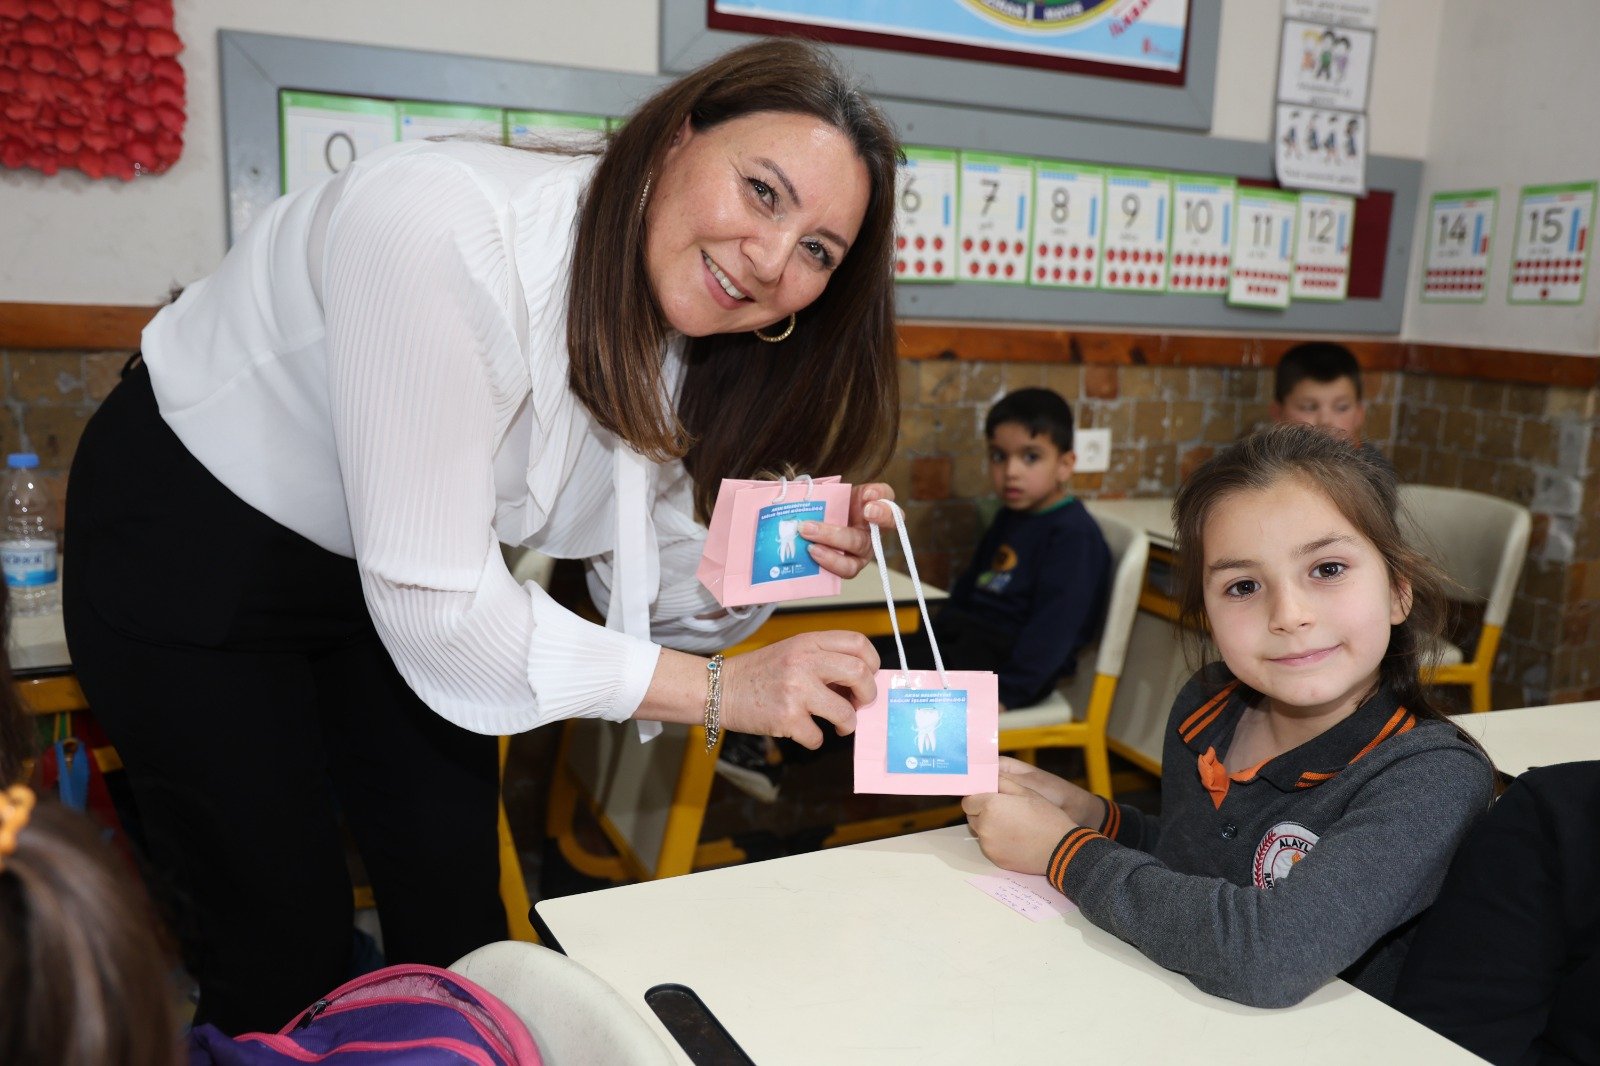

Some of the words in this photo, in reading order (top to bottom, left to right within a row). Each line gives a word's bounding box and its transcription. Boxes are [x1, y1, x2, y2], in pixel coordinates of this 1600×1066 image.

[901, 175, 922, 214] 6
[980, 178, 1000, 217] 7
[1051, 187, 1070, 224] 8
[1121, 193, 1141, 229] 9
[1184, 199, 1213, 234] 10
[1252, 214, 1272, 247] 11
[1308, 209, 1336, 243] 12
[1438, 212, 1467, 246] 14
[1529, 207, 1565, 244] 15
[1279, 838, 1309, 853] ALAYL
